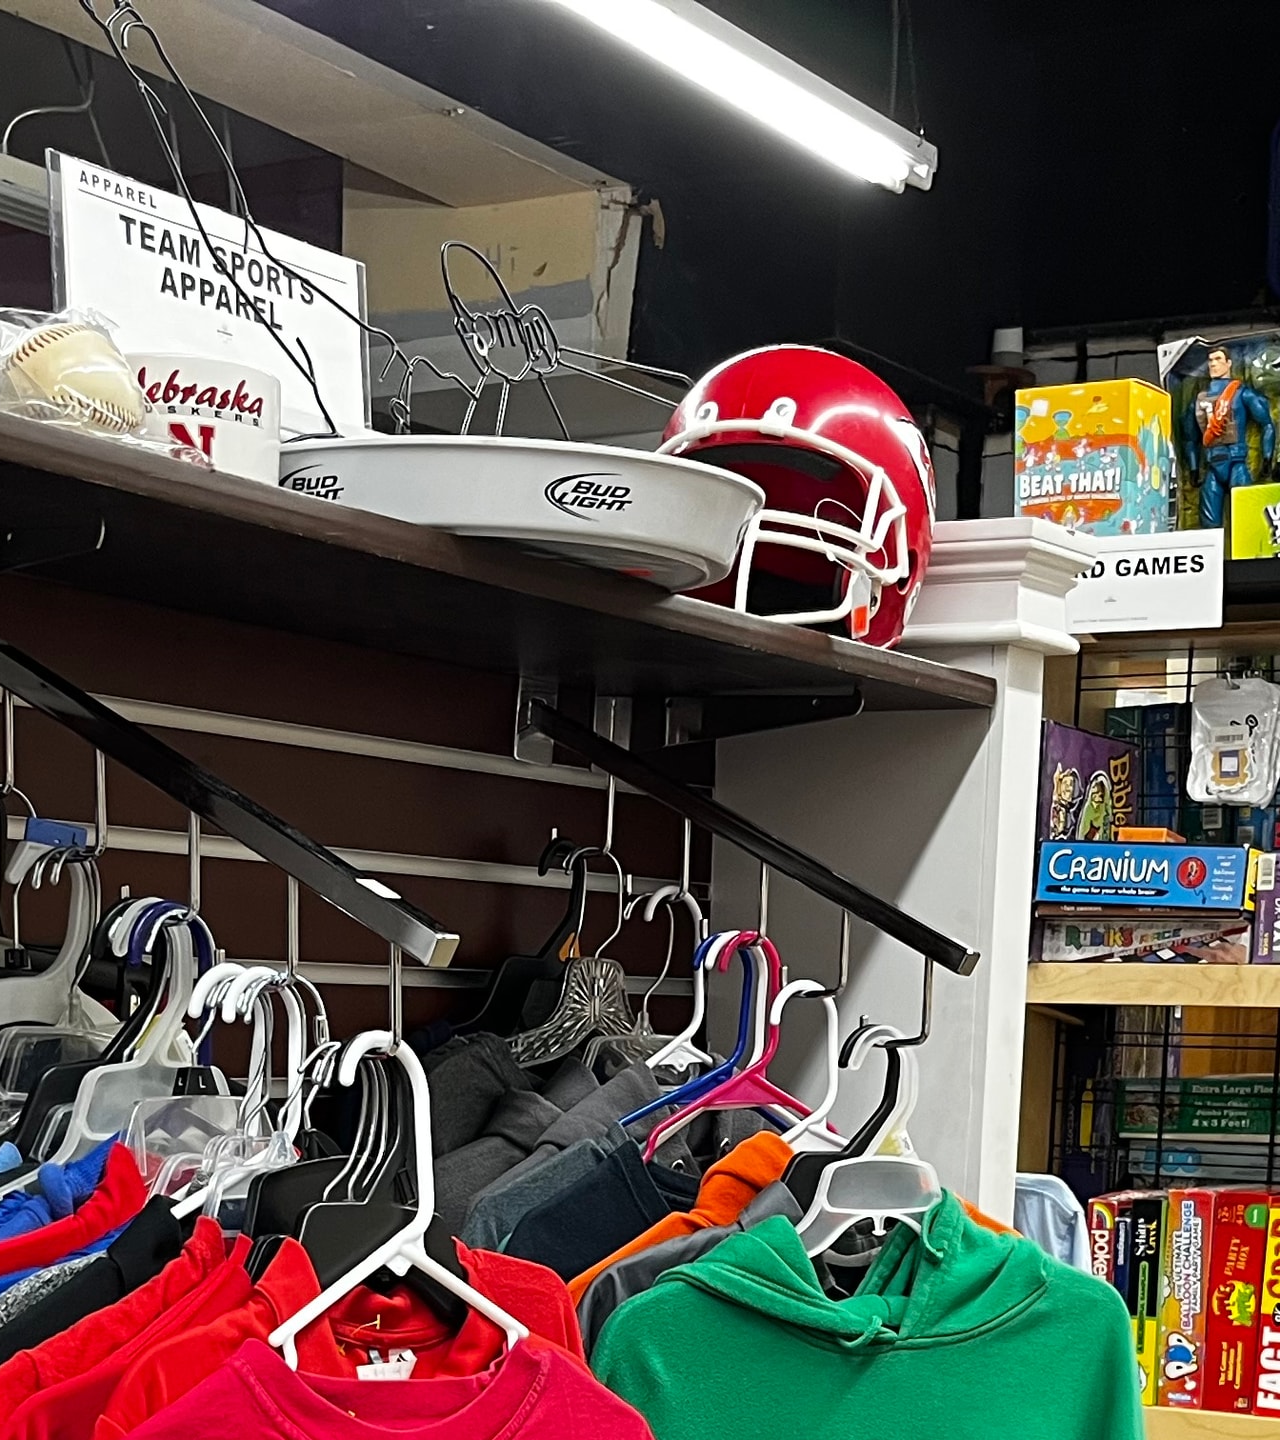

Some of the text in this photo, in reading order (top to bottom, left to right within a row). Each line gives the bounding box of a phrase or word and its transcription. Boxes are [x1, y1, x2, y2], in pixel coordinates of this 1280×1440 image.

[79, 169, 157, 209] APPAREL
[118, 213, 315, 305] TEAM SPORTS
[160, 267, 283, 331] APPAREL
[145, 398, 260, 427] USKERS
[291, 475, 338, 491] BUD
[573, 480, 632, 499] BUD
[1020, 466, 1121, 499] BEAT THAT!
[558, 492, 633, 512] LIGHT
[1115, 554, 1205, 578] GAMES
[198, 1075, 207, 1089] L
[1192, 1084, 1220, 1094] Extra
[1222, 1085, 1252, 1095] Large
[1253, 1085, 1280, 1094] Floo
[1192, 1119, 1200, 1127] 2
[1220, 1118, 1251, 1129] Feet!
[1173, 1232, 1183, 1282] ULTIMATE
[1181, 1202, 1194, 1328] BALLOON CHALLENGE
[1191, 1248, 1200, 1279] PARTY
[1224, 1236, 1241, 1277] PARTY
[1236, 1245, 1250, 1271] BOX
[1191, 1279, 1201, 1312] FAMILY
